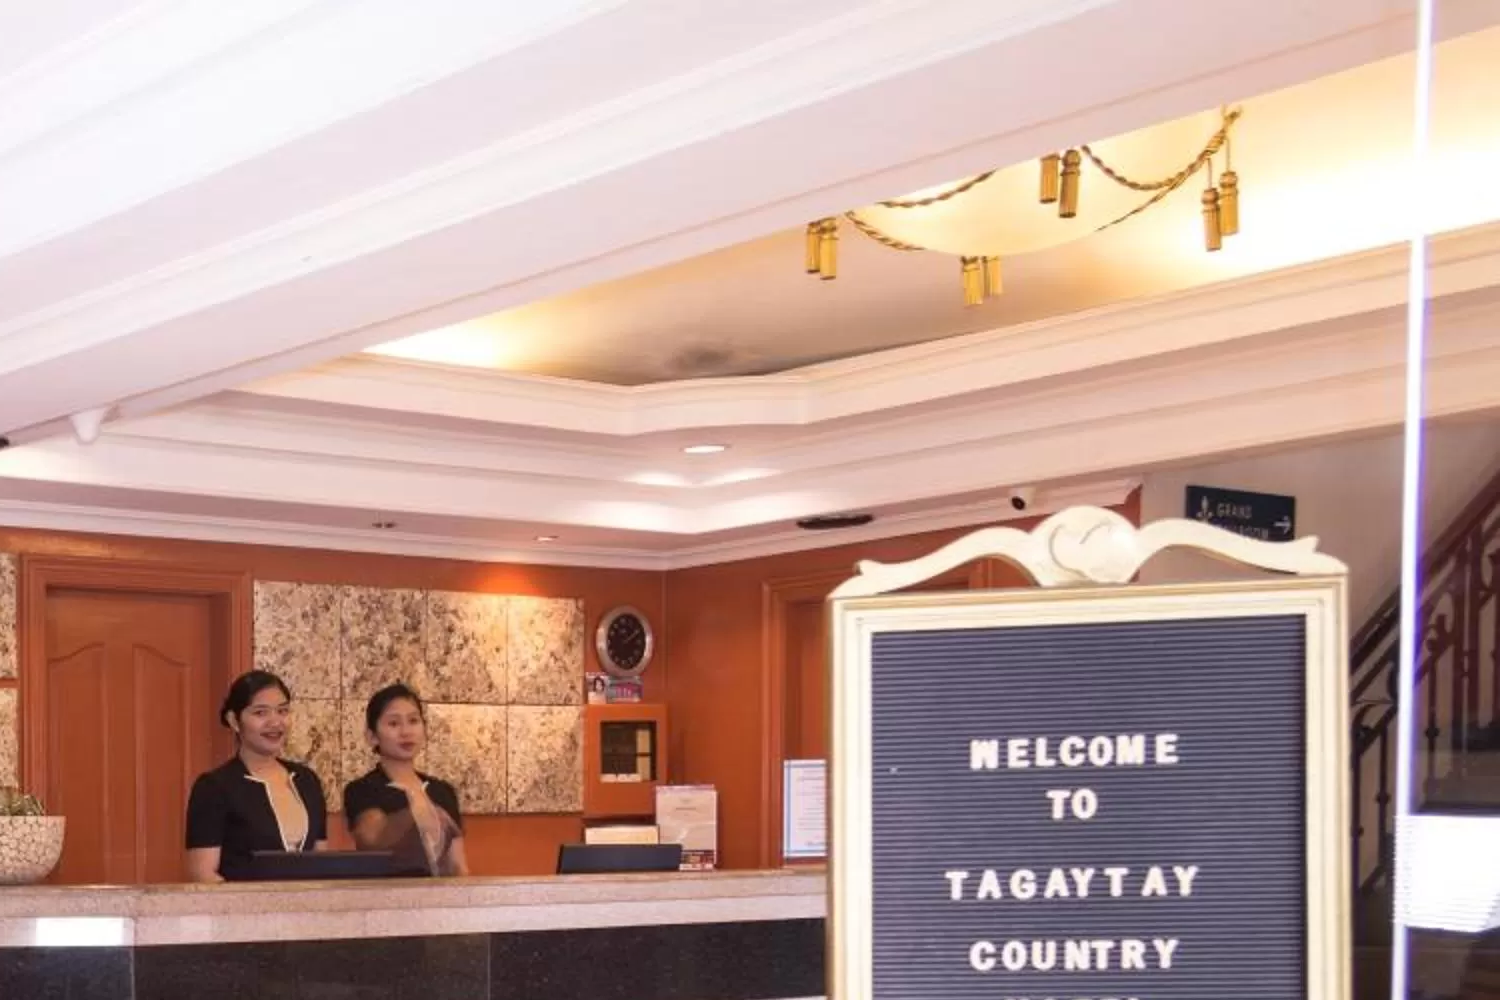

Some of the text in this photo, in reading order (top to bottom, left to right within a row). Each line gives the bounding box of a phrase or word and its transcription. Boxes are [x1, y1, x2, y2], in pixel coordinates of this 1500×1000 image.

[969, 733, 1179, 770] WELCOME
[1046, 788, 1098, 820] TO
[944, 865, 1199, 901] TAGAYTAY
[969, 938, 1179, 972] COUNTRY
